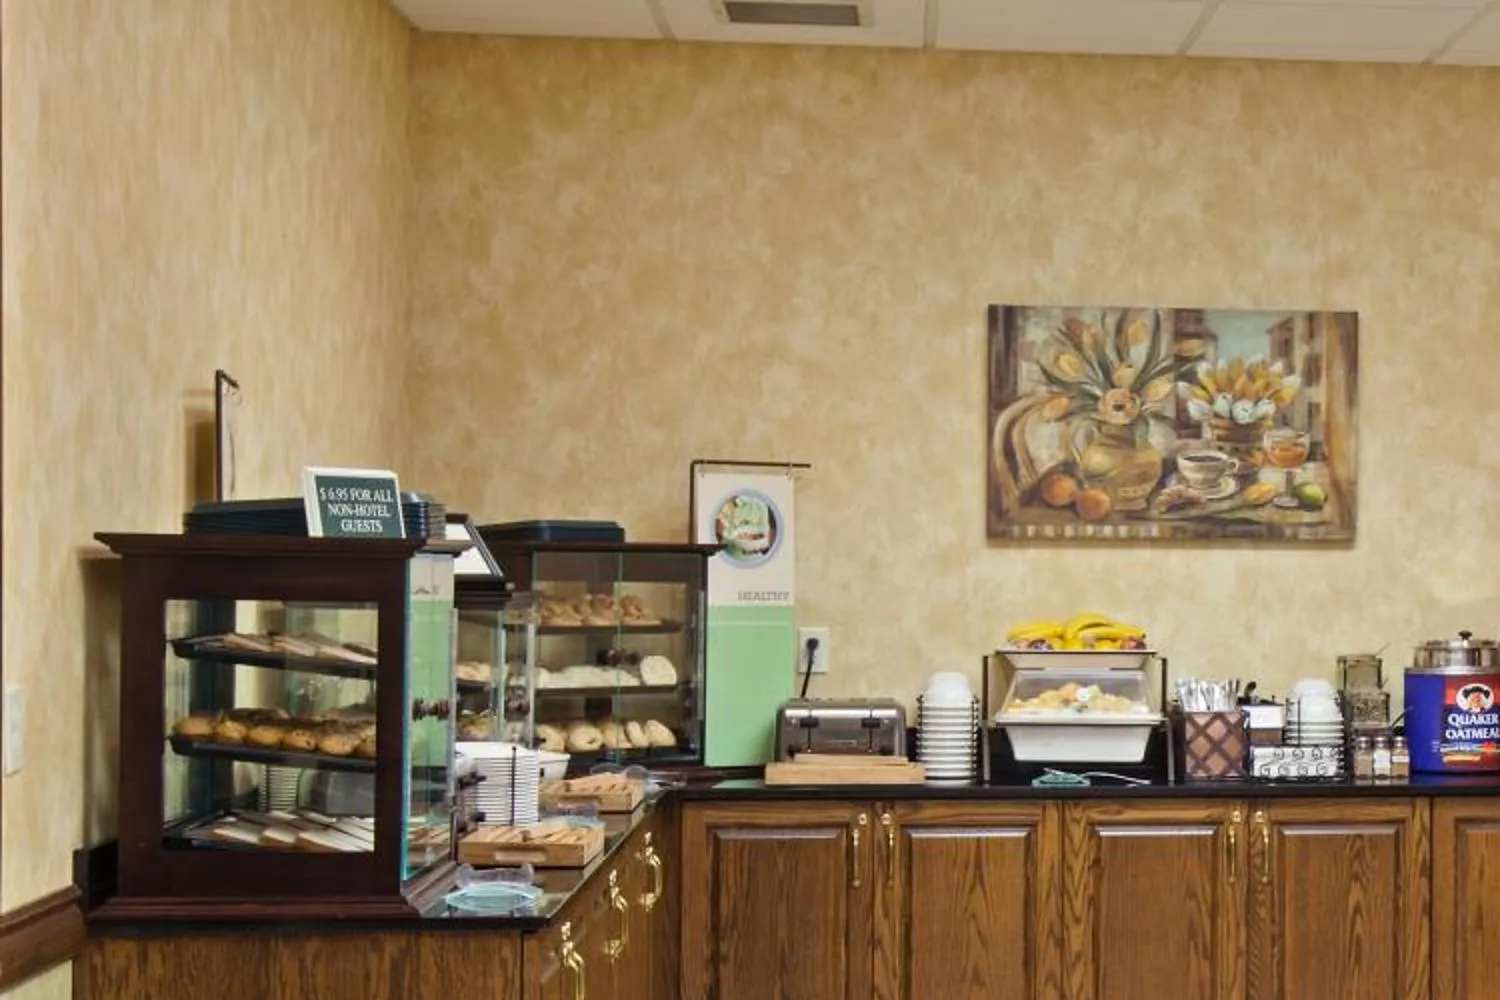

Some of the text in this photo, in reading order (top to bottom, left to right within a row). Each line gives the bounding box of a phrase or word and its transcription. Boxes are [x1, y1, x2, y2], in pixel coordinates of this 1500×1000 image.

[349, 487, 373, 501] FOR
[373, 488, 394, 503] ALL
[327, 503, 391, 517] NON-HOTEL
[341, 518, 383, 533] GUESTS
[737, 590, 790, 601] HEALTHY
[1447, 713, 1499, 727] QUAKER
[1445, 727, 1500, 740] OATMEAL
